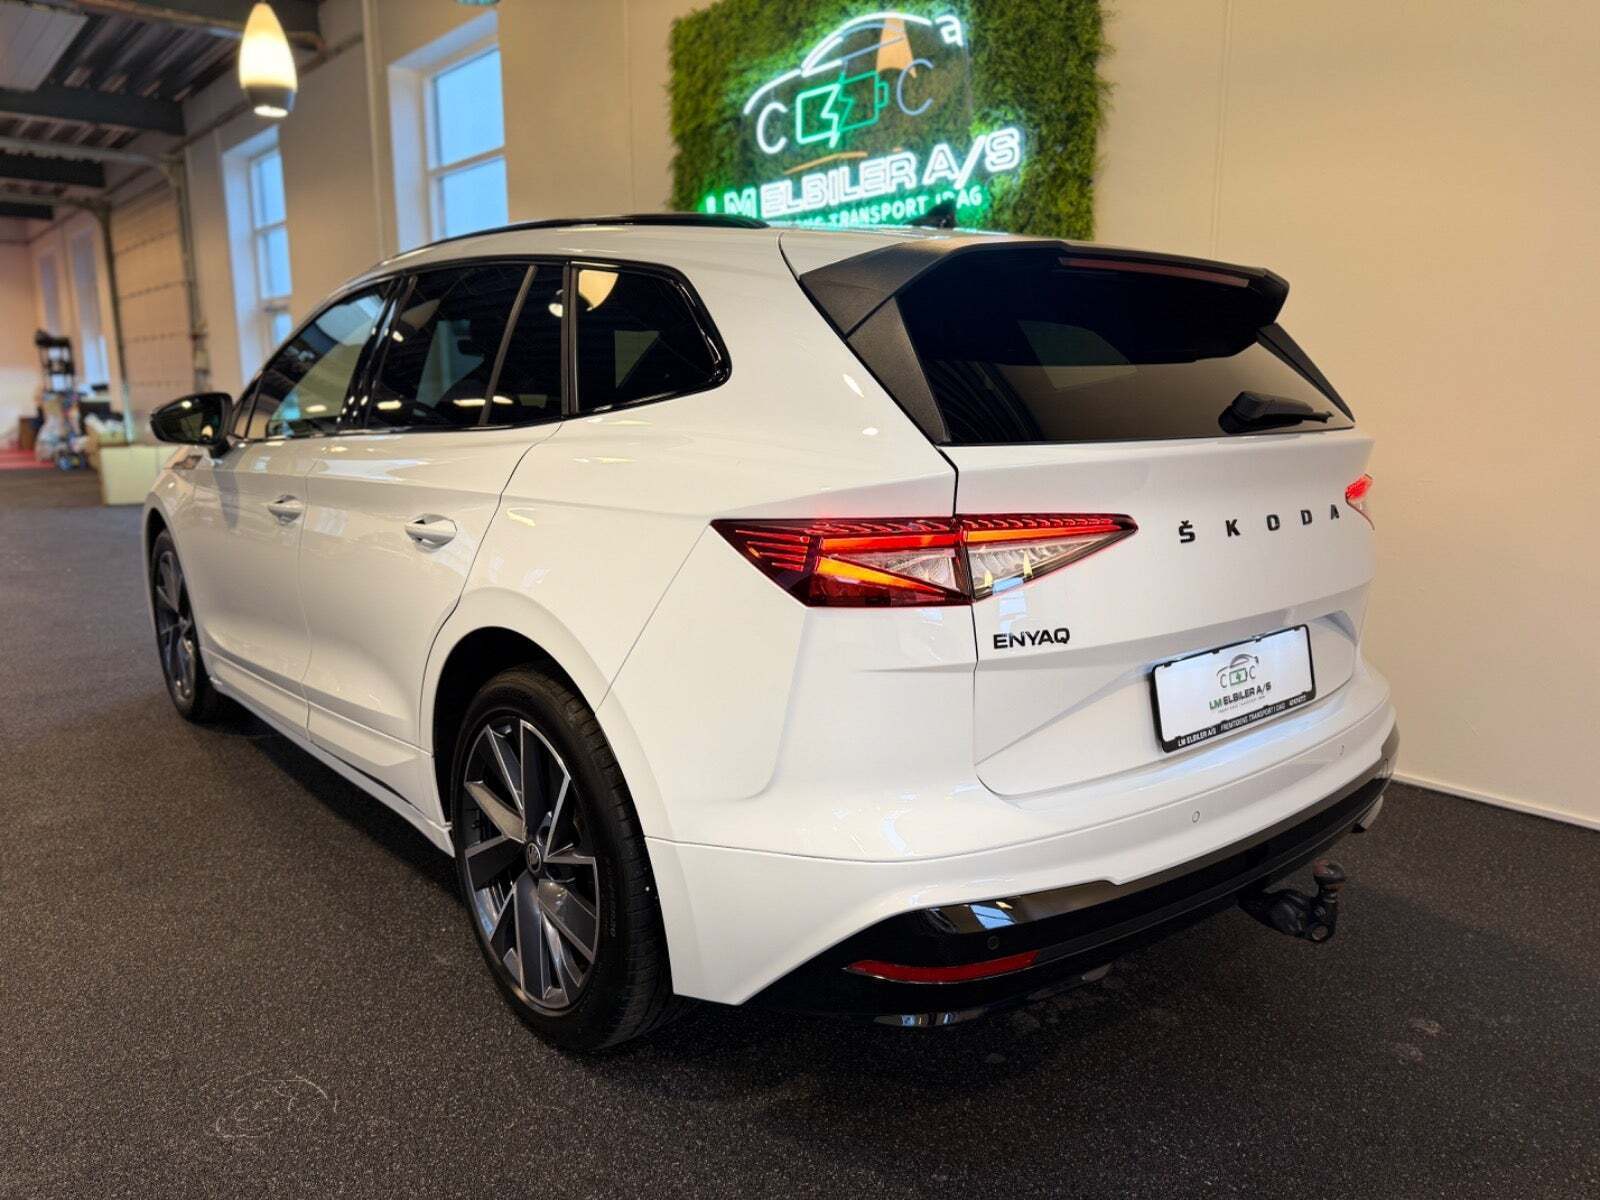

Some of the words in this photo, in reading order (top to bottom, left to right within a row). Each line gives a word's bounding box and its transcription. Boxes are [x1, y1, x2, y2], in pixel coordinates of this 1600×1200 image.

[760, 151, 917, 218] ELBILER
[921, 127, 1020, 190] A/S
[1178, 504, 1340, 544] ŠKODA
[993, 627, 1070, 649] ENYAQ
[1209, 698, 1222, 710] LM
[1223, 687, 1255, 705] ELBILER
[1256, 681, 1271, 696] A/S
